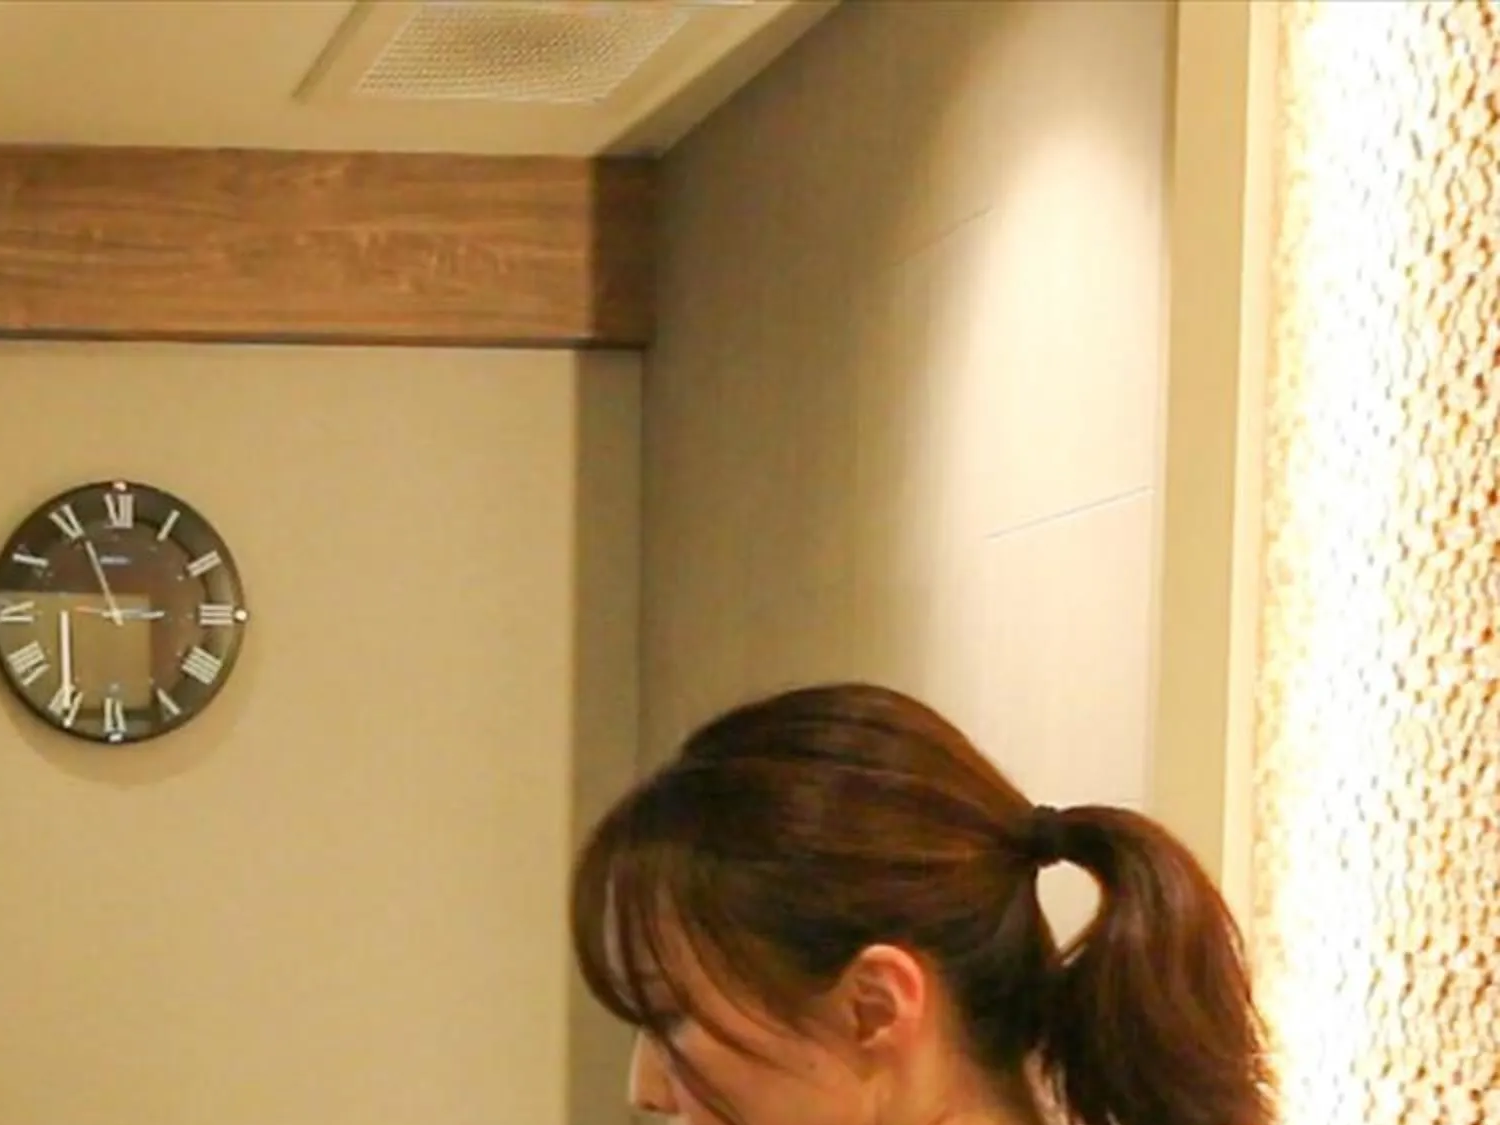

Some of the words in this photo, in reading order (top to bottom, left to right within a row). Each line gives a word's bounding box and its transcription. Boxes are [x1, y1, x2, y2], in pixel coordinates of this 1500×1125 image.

[156, 509, 181, 542] I
[186, 550, 223, 578] II
[199, 603, 234, 627] III
